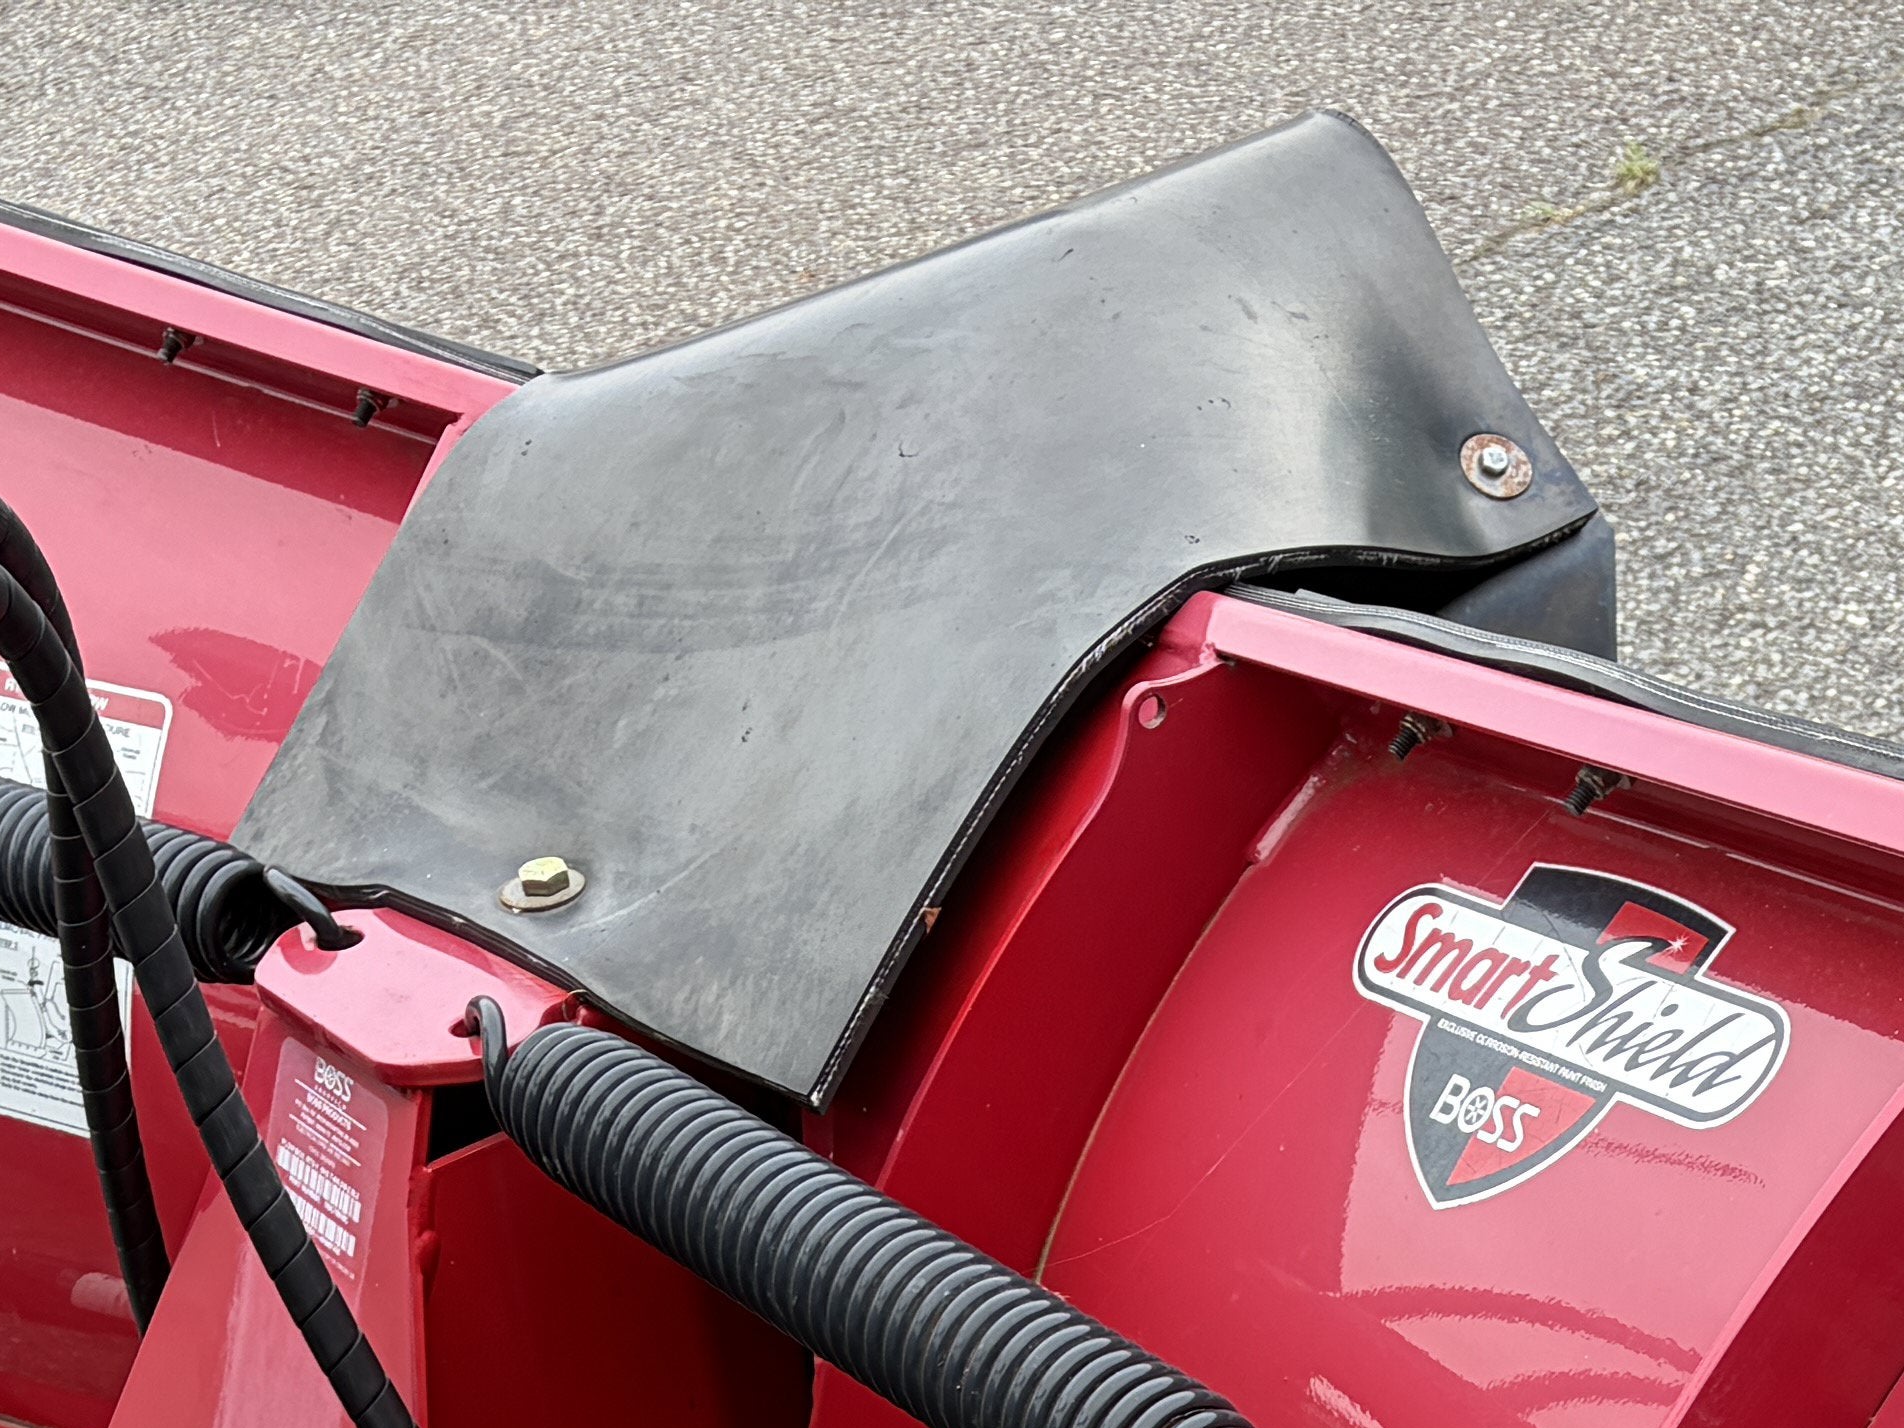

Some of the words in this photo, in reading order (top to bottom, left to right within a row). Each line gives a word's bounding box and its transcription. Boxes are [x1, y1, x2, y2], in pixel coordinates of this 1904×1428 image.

[1373, 902, 1563, 1020] Smart
[1508, 938, 1778, 1098] Shield
[315, 1056, 354, 1102] BOSS
[1429, 1074, 1542, 1154] BOSS
